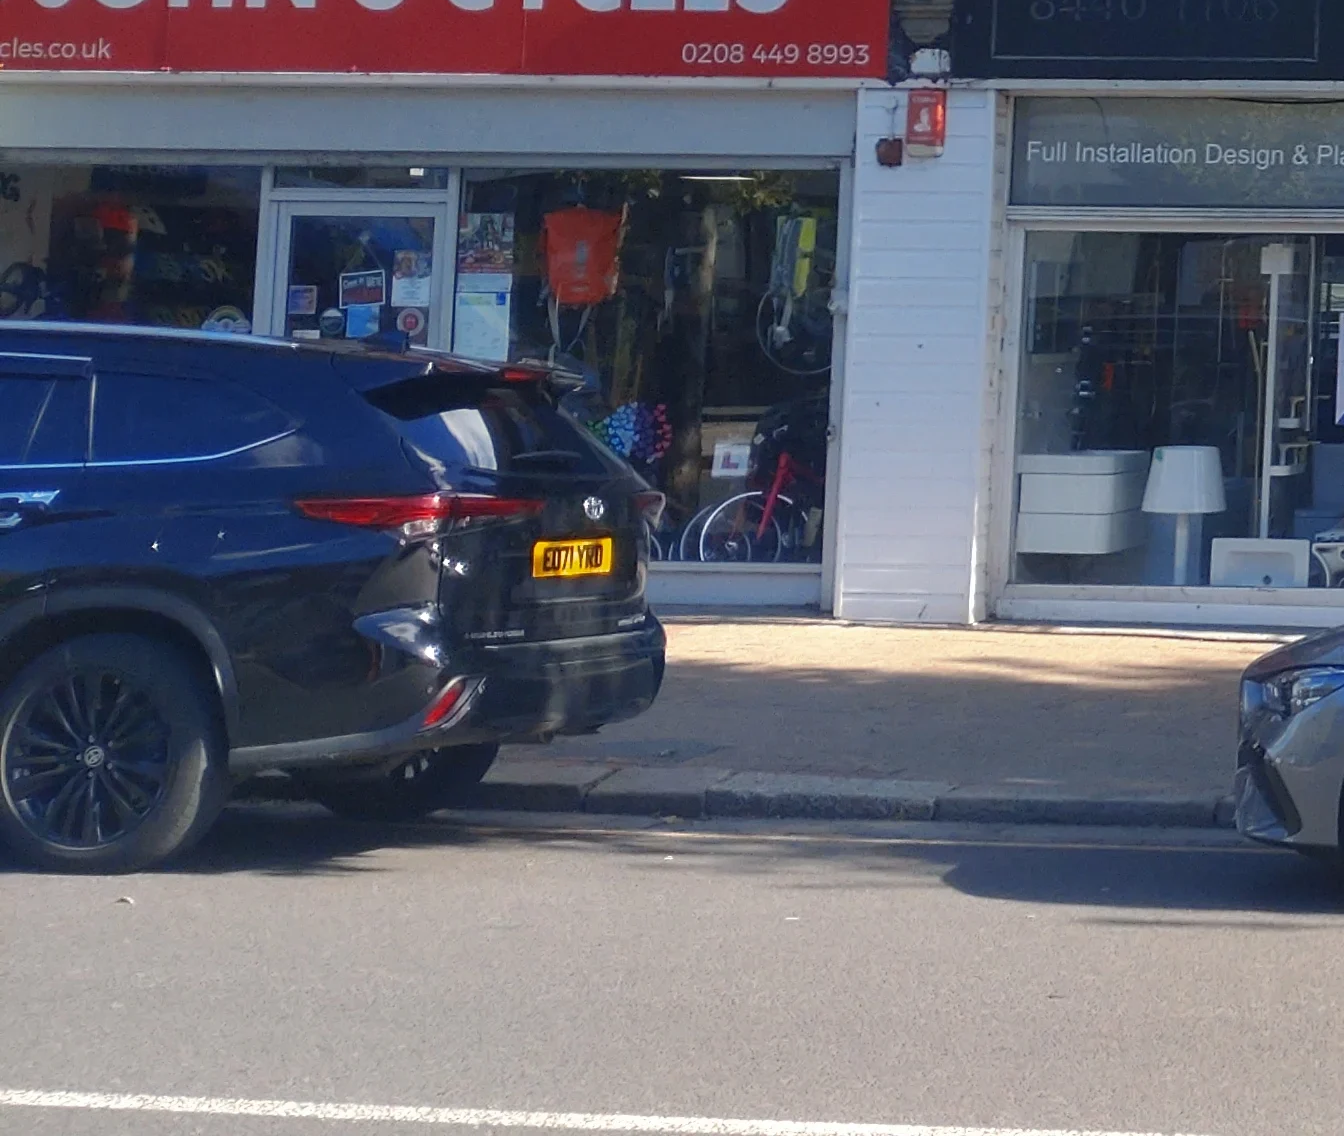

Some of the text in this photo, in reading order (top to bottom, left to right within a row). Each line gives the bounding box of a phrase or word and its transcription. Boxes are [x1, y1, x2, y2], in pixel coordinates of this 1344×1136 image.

[682, 43, 870, 65] 0208 449 8993
[1026, 141, 1066, 163] Full
[1075, 142, 1197, 165] Installation
[1205, 144, 1284, 170] Design
[1292, 145, 1309, 165] &
